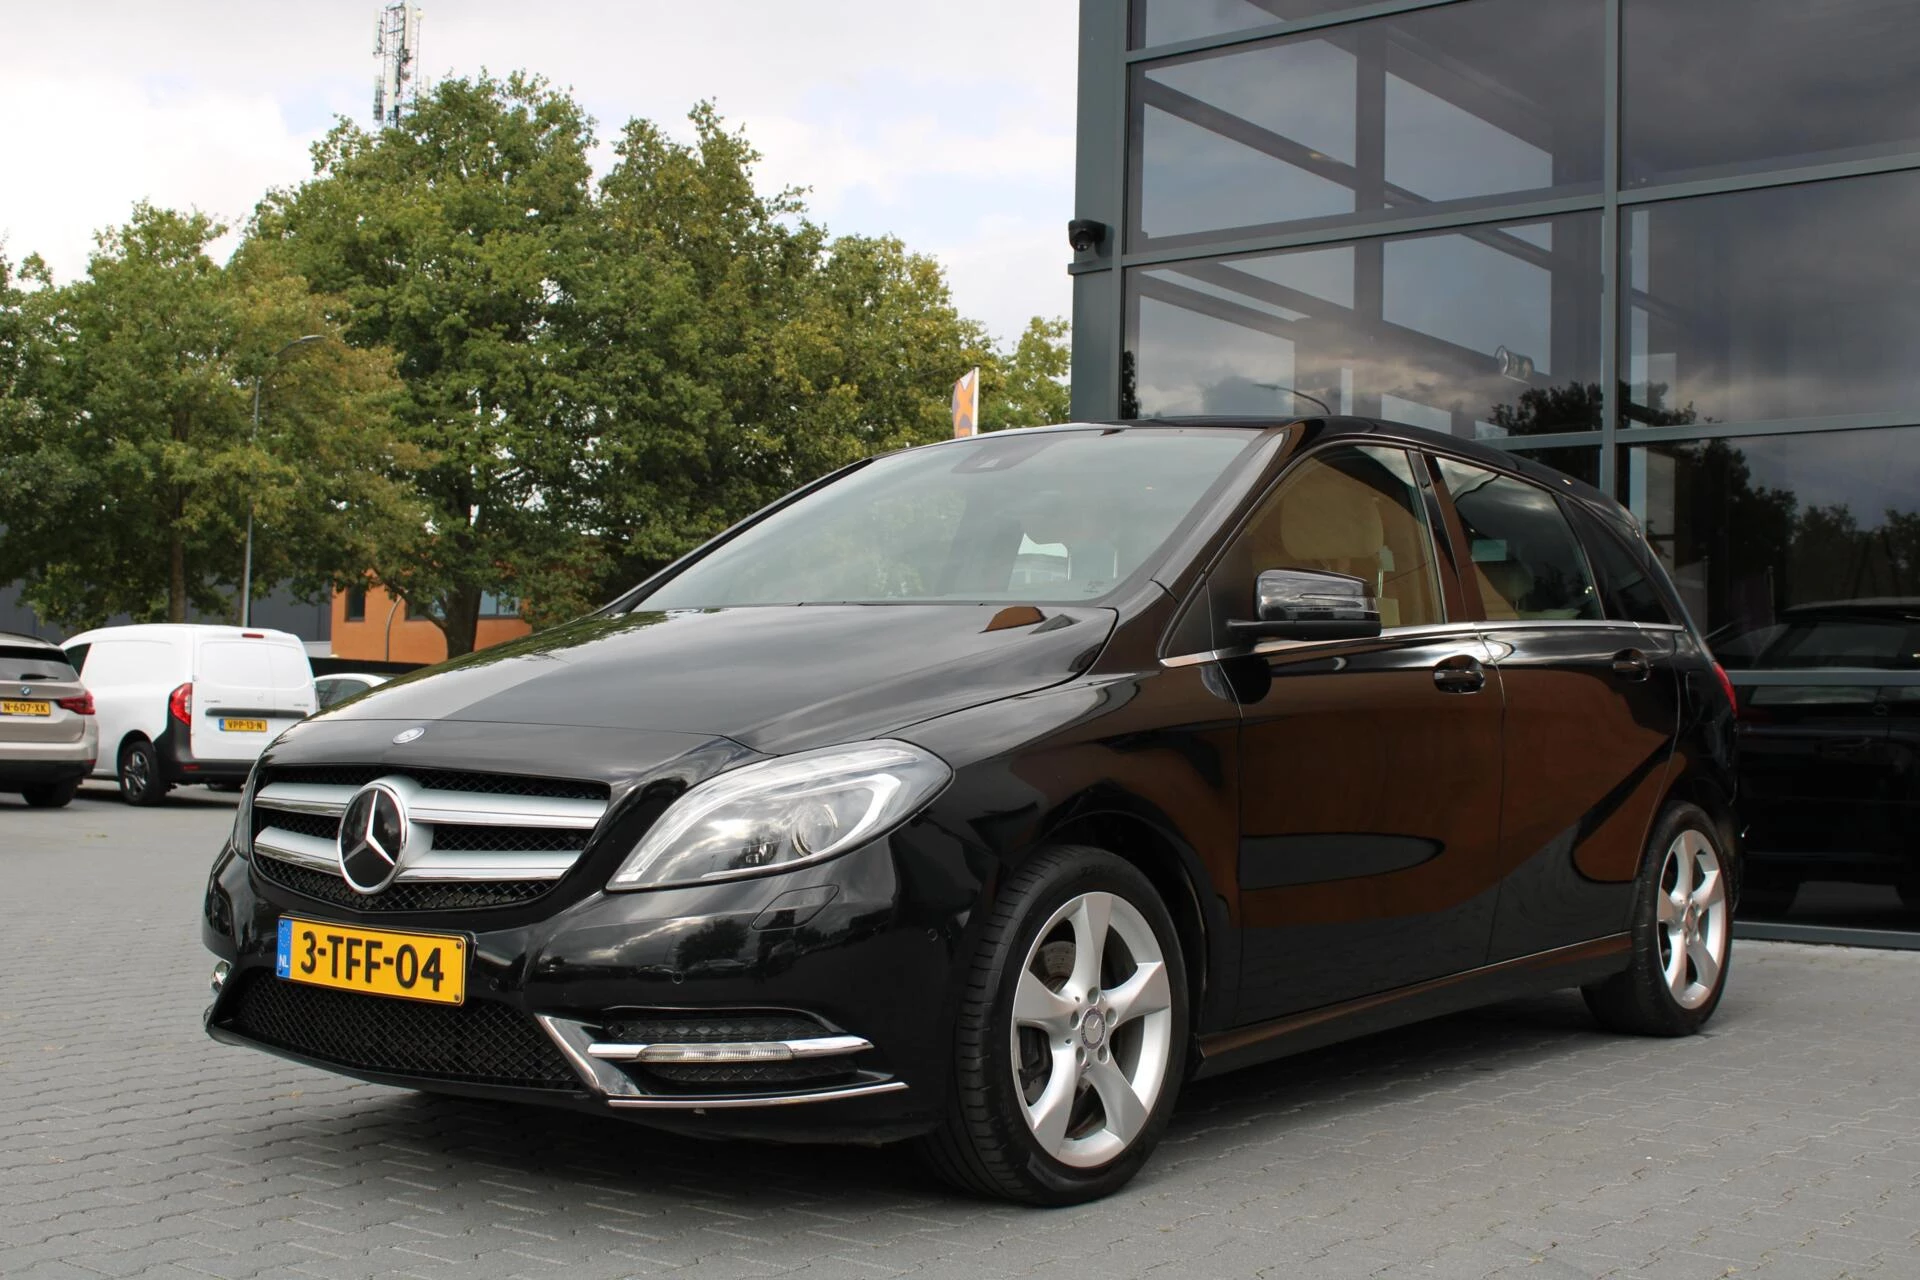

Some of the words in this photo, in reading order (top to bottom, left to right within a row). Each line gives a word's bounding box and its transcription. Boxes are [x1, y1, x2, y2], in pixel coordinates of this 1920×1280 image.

[3, 703, 47, 712] N-607-XK
[279, 954, 289, 968] NL
[301, 931, 444, 992] 3-TFF-04
